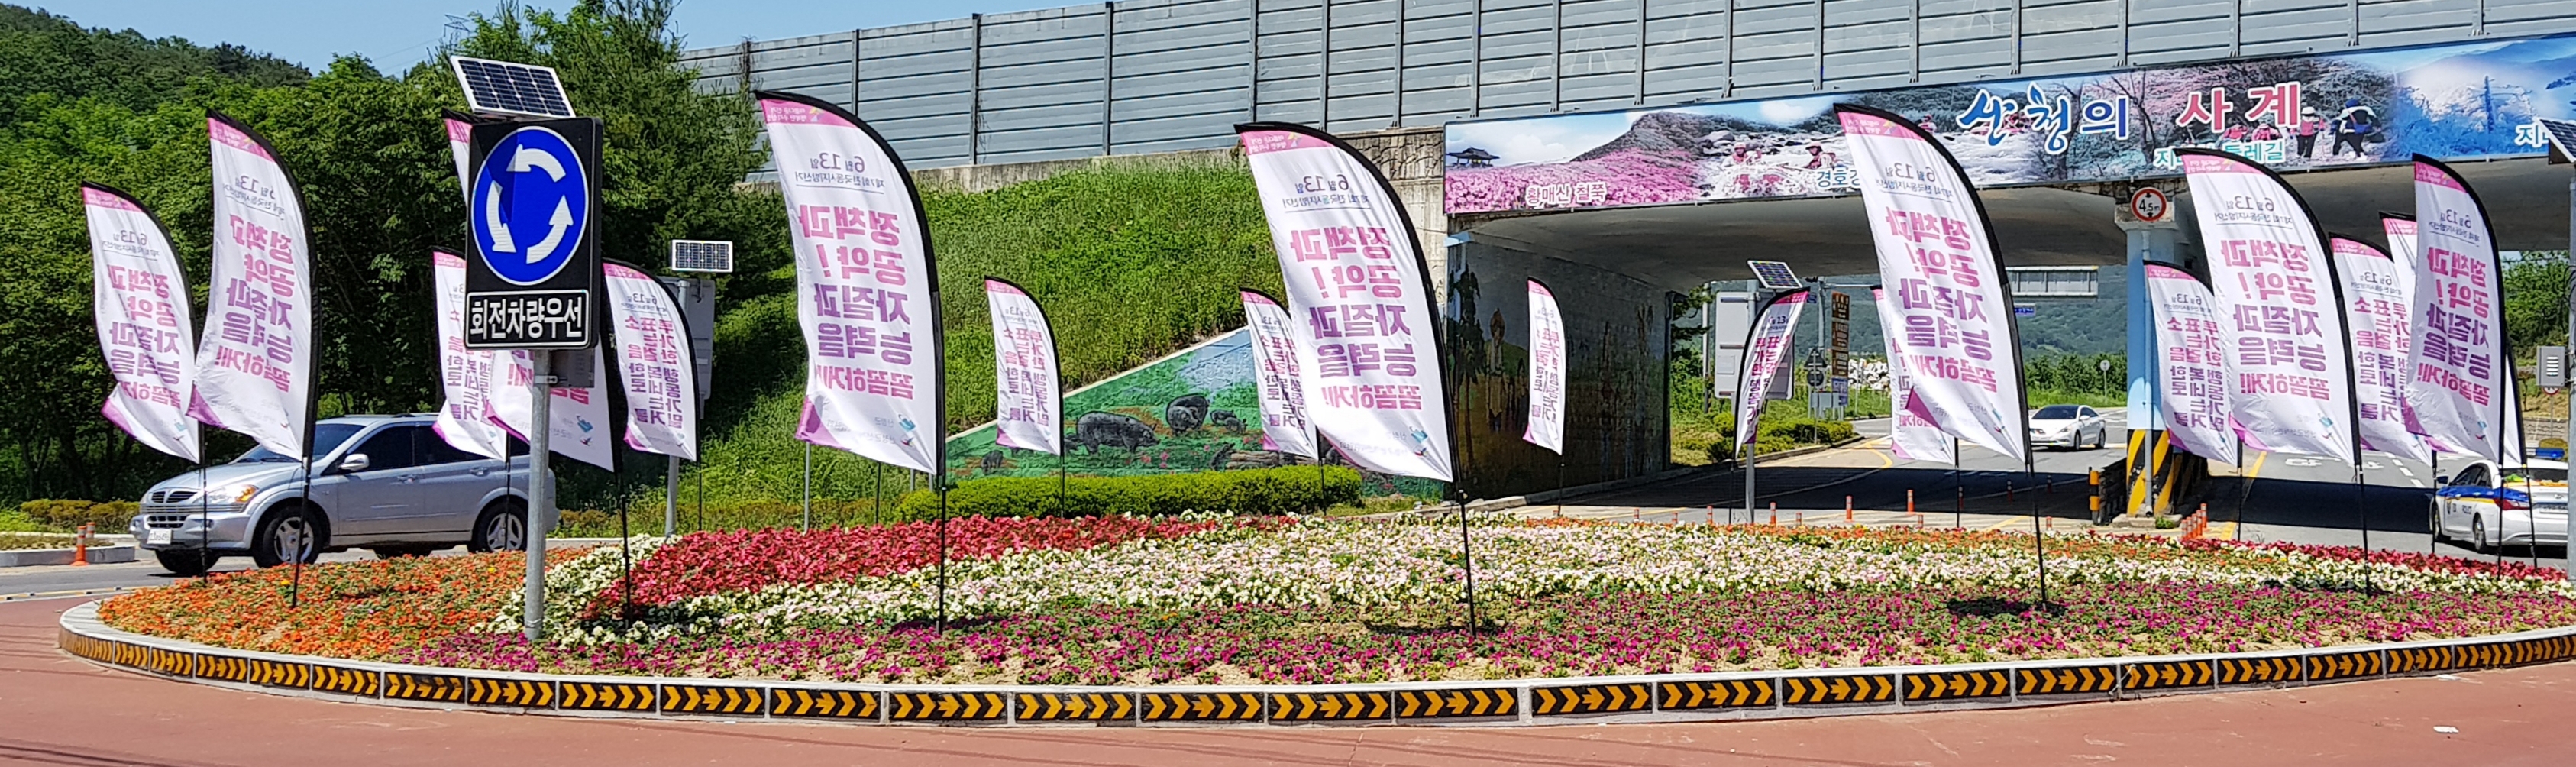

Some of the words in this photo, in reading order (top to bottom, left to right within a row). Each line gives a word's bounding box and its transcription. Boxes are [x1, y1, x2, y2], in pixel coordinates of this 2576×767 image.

[1959, 84, 2128, 152] 산청의
[1527, 185, 1570, 204] 황매산
[1576, 184, 1605, 201] 철쭉
[470, 296, 582, 339] 회전차량우선
